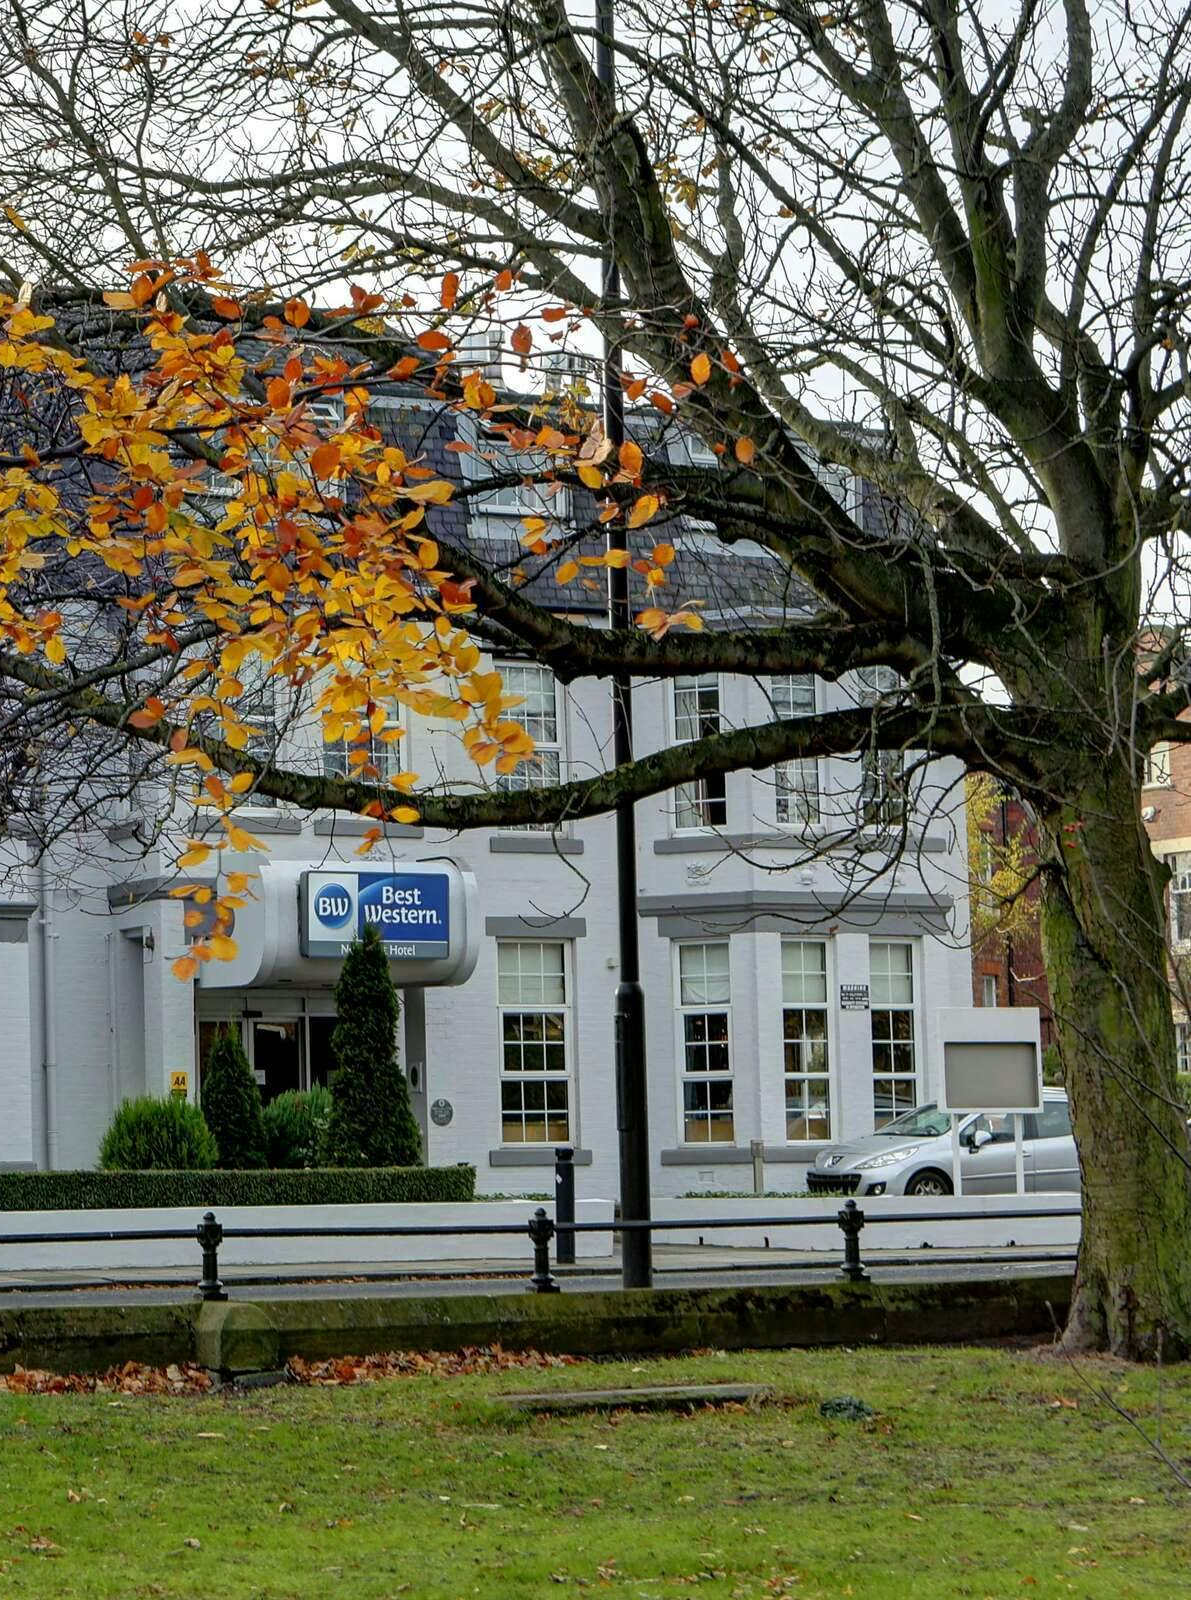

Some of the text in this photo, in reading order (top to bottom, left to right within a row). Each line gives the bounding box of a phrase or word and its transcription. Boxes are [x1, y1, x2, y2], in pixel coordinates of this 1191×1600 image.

[381, 886, 422, 905] Best
[319, 897, 349, 916] BW
[390, 945, 416, 956] Hotel
[173, 1076, 186, 1086] AA
